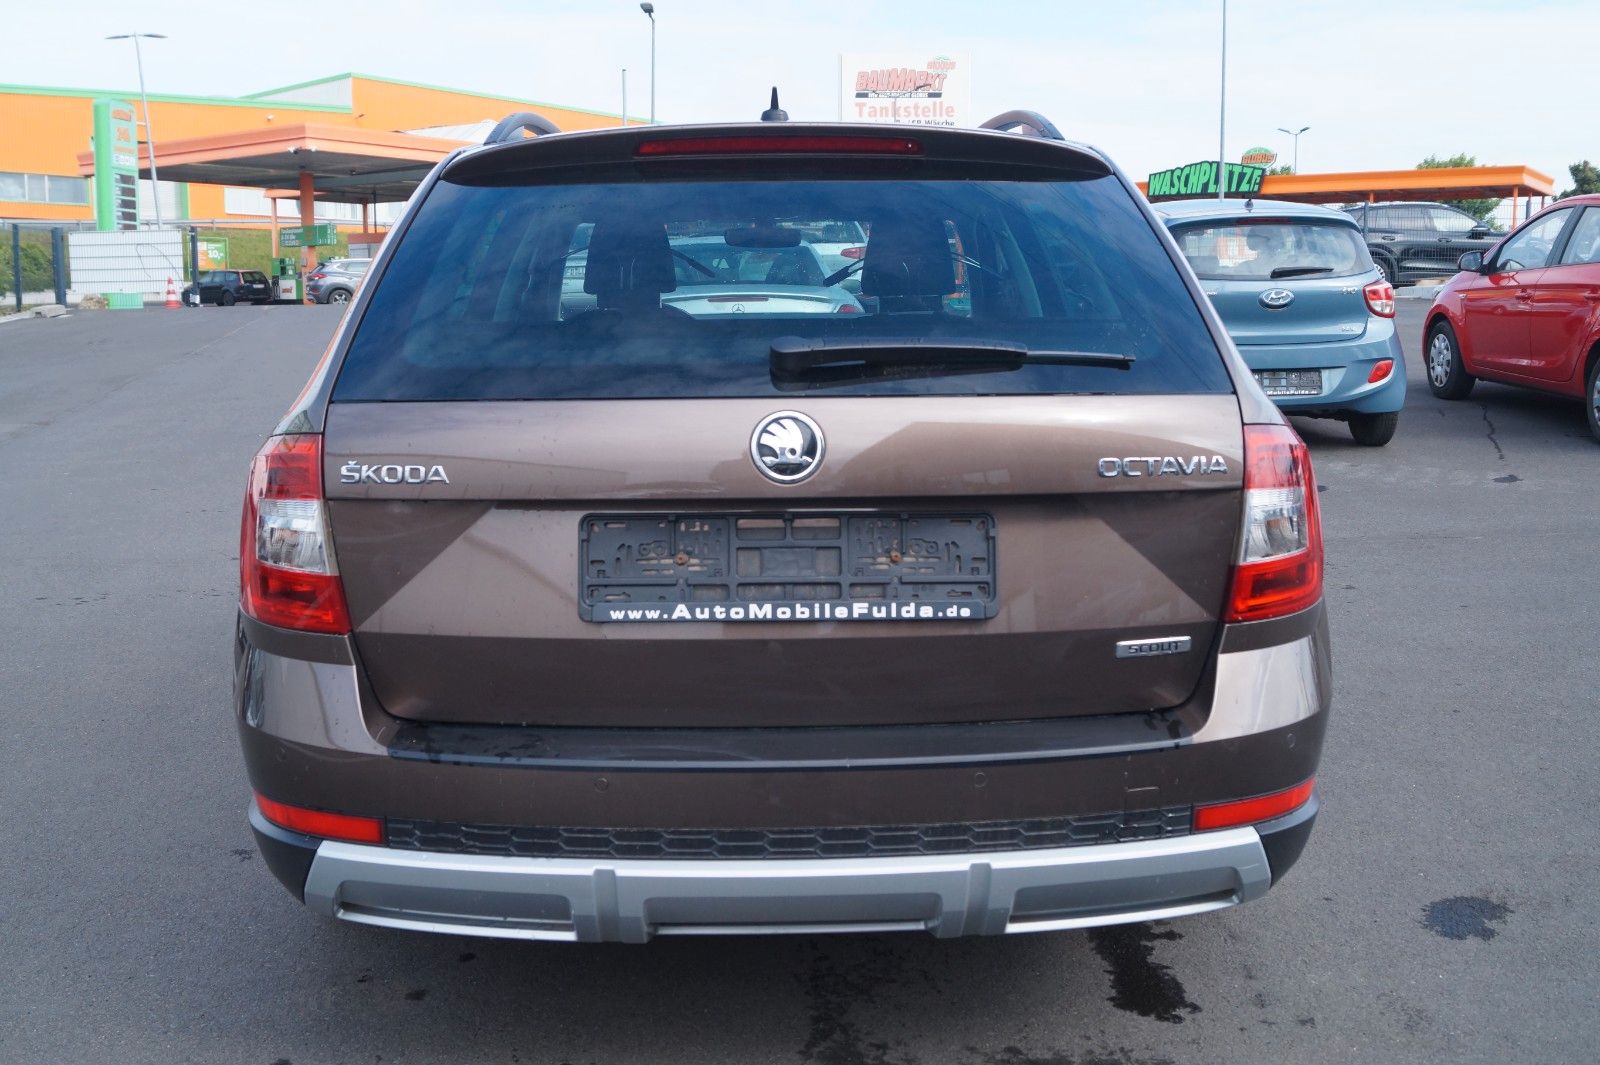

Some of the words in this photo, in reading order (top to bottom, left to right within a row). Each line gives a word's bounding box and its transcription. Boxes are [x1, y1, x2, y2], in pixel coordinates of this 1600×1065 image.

[856, 68, 947, 92] BAUMARKT
[855, 101, 955, 118] Tankstelle
[340, 460, 450, 484] ŠKODA
[1098, 455, 1228, 478] OCTAVIA
[609, 603, 972, 621] www.AutoMobileFulda.de
[1128, 640, 1184, 654] SCOUT
